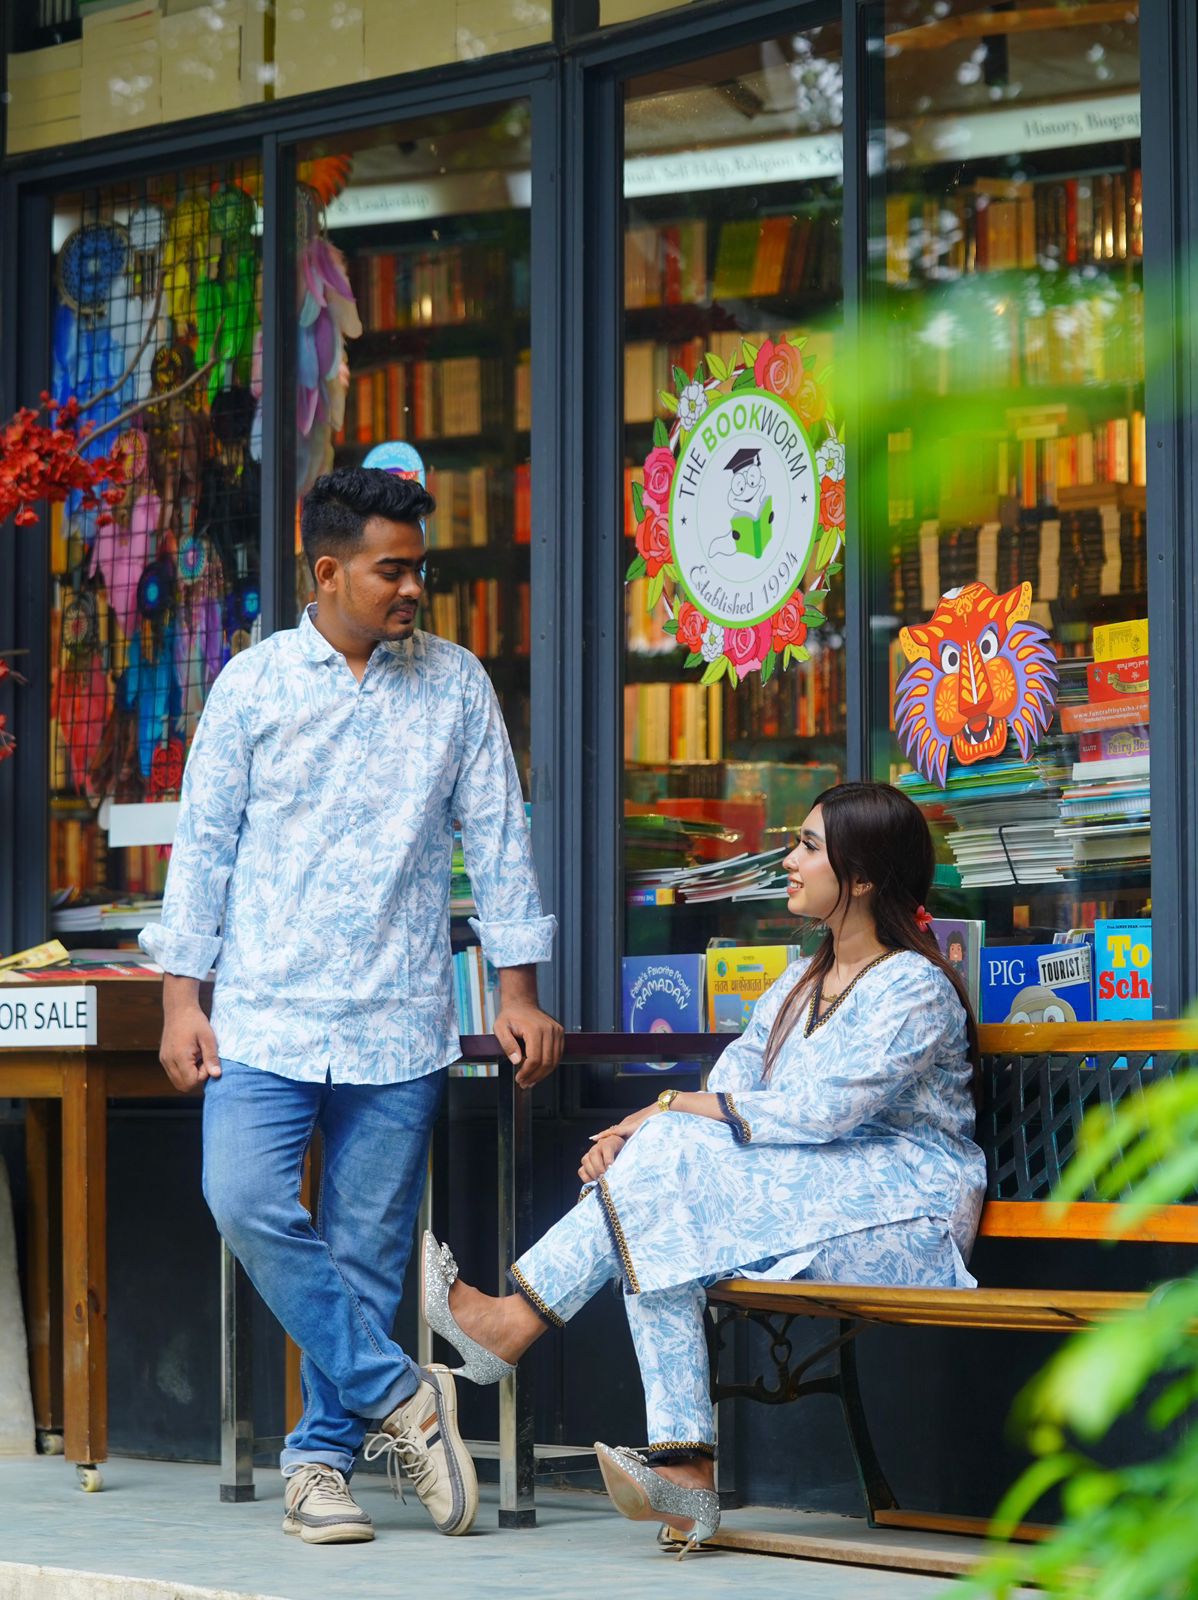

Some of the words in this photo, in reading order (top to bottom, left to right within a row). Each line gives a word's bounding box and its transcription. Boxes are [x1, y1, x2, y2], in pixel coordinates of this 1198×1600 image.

[678, 448, 706, 500] THE
[701, 403, 807, 481] BOOKWORM
[689, 564, 754, 615] Established
[761, 550, 799, 602] 1994
[1107, 740, 1133, 757] Fairy
[1107, 935, 1151, 968] To
[647, 965, 674, 976] Favorite
[674, 970, 692, 998] Month
[988, 959, 1026, 986] PIG
[1041, 956, 1081, 984] TOURIST
[1099, 970, 1152, 999] Sch
[635, 978, 688, 1010] RAMADAN
[0, 1003, 27, 1030] OR
[34, 1001, 88, 1030] SALE
